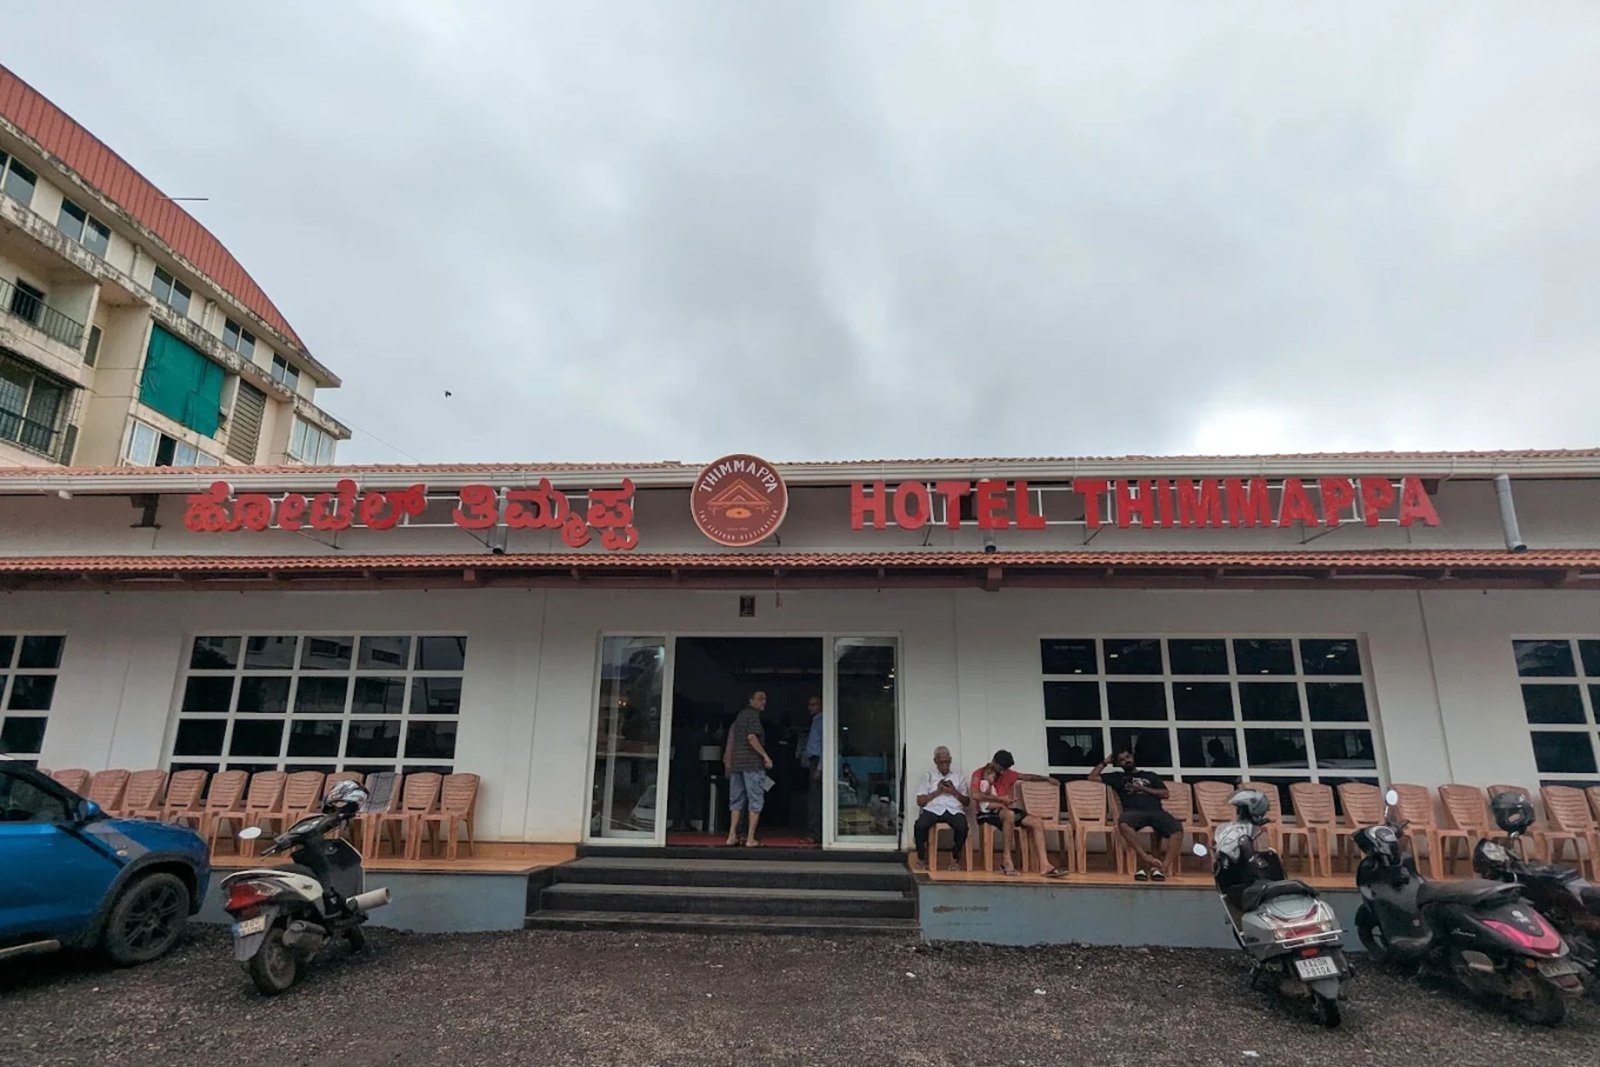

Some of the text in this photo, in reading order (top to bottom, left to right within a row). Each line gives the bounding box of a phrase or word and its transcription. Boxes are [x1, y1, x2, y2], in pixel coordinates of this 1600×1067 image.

[698, 460, 778, 493] THIMMAPPA
[452, 477, 639, 550] ತಿಮ್ಮಪ್ಪ
[850, 477, 1441, 530] HOTEL THIMMAPPA
